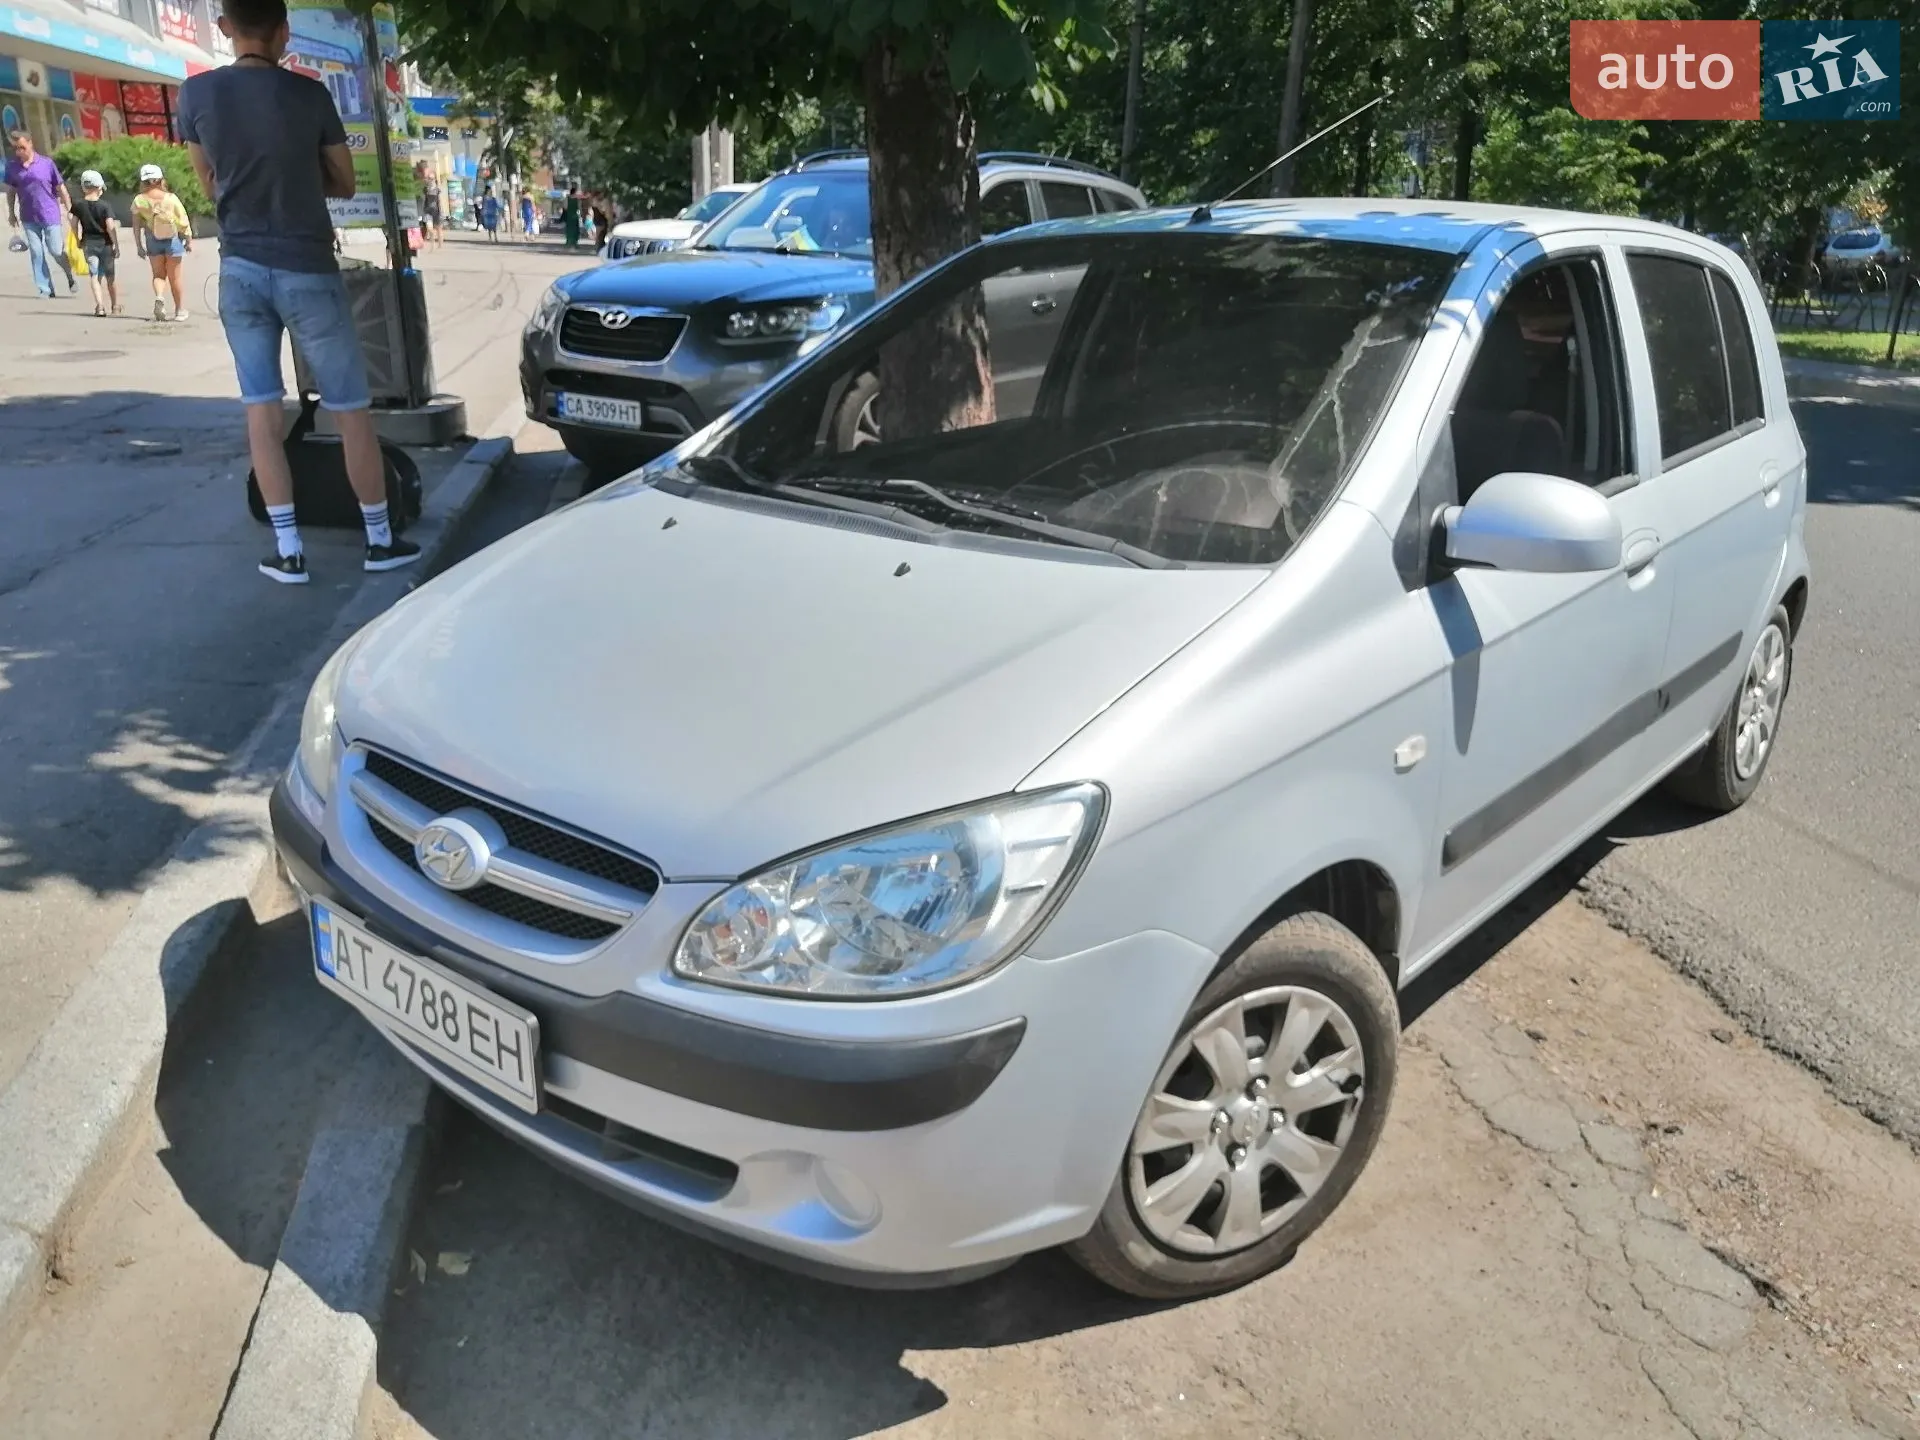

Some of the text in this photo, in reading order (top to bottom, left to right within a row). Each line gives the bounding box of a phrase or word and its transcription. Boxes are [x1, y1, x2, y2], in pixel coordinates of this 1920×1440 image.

[566, 396, 638, 422] CA 3909 HT
[335, 927, 524, 1083] AT 4788 EH
